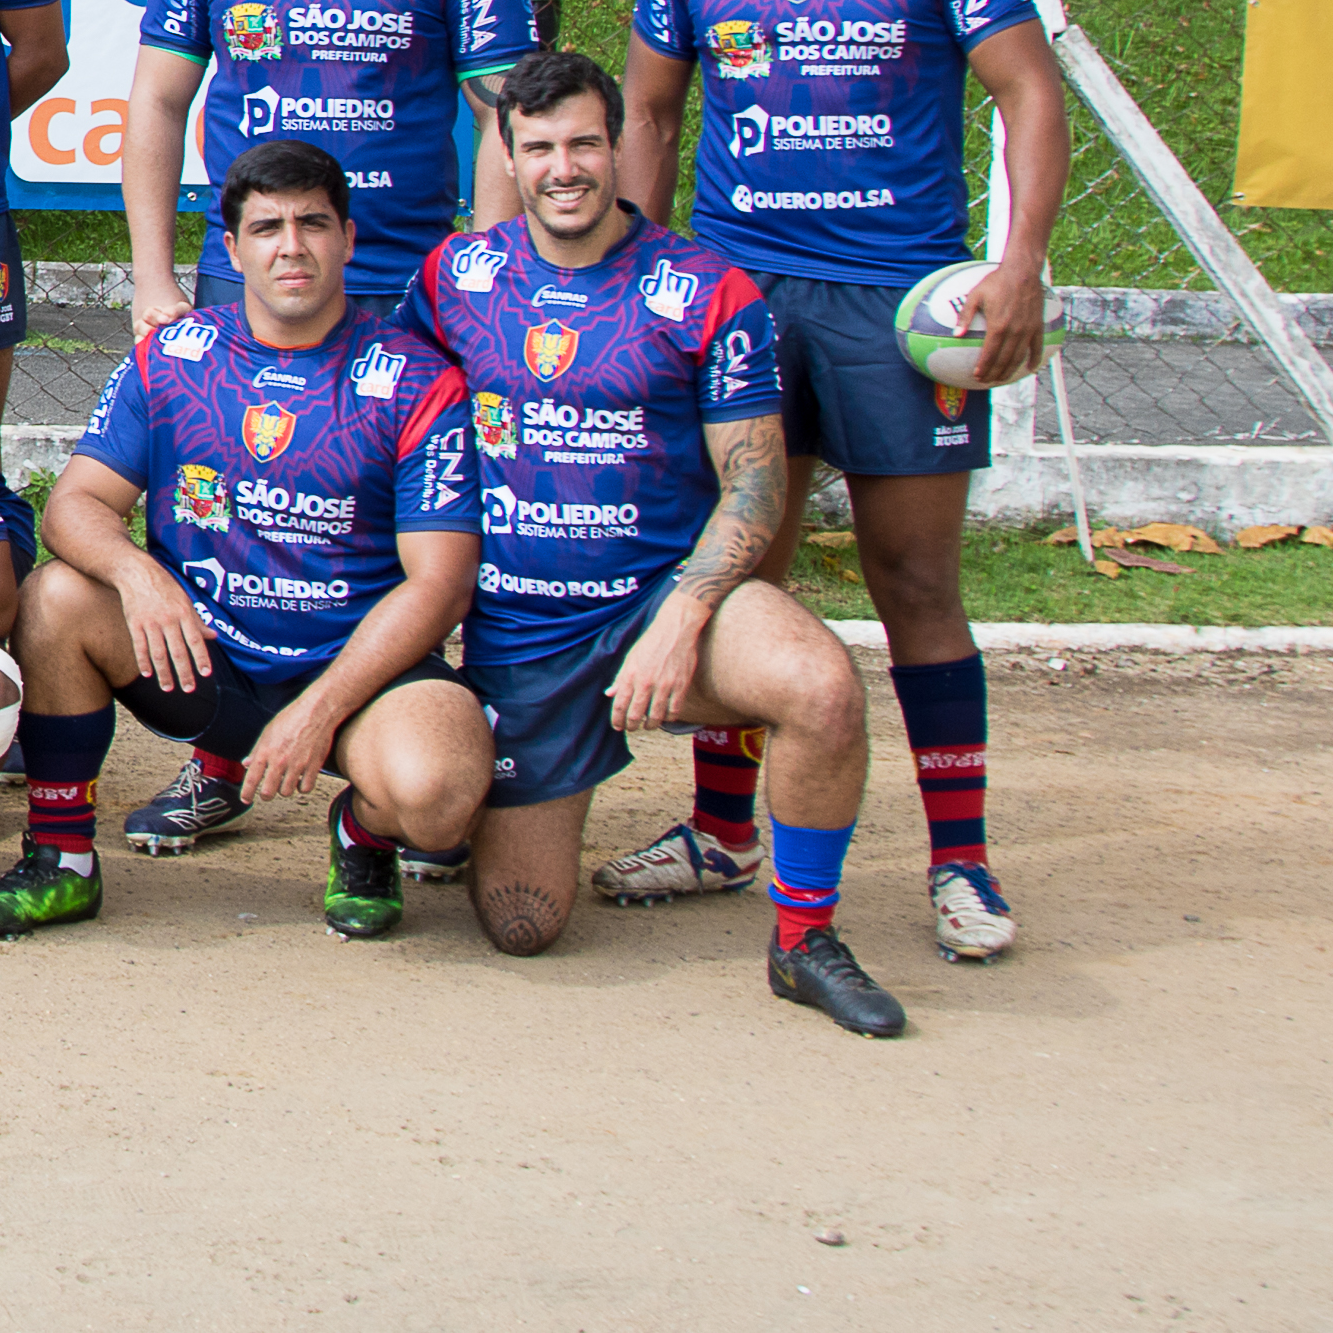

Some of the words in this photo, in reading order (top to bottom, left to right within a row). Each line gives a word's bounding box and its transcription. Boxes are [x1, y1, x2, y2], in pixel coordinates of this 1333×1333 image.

[289, 4, 345, 30] SÃO
[346, 9, 414, 36] JOSÉ
[776, 16, 836, 43] SÃO
[836, 19, 908, 44] JOSÉ
[289, 30, 329, 46] DOS
[331, 32, 411, 50] CAMPOS
[311, 50, 387, 64] PREFEITURA
[779, 45, 821, 61] DOS
[822, 44, 904, 60] CAMPOS
[801, 64, 880, 77] PREFEITURA
[281, 98, 393, 118] POLIEDRO
[281, 118, 330, 131] SISTEMA
[332, 119, 349, 131] DE
[351, 119, 395, 132] ENSINO
[771, 114, 891, 137] POLIEDRO
[773, 136, 822, 150] SISTEMA
[824, 136, 842, 149] DE
[845, 135, 893, 149] ENSINO
[753, 189, 826, 209] QUERO
[827, 189, 896, 209] BOLSA
[639, 259, 698, 304] dm
[541, 288, 588, 304] SANRAD
[648, 299, 683, 319] card
[159, 317, 218, 350] dm
[165, 341, 202, 361] card
[351, 343, 406, 388] dm
[262, 371, 307, 387] SANRAD
[358, 378, 394, 396] card
[523, 398, 579, 429] SÃO
[579, 406, 644, 432] JOSÉ
[524, 428, 563, 447] DOS
[565, 430, 648, 449] CAMPOS
[544, 451, 626, 465] PREFEITURA
[434, 427, 465, 511] CNA
[236, 479, 290, 511] SÃO
[292, 492, 356, 520] JOSÉ
[237, 506, 273, 527] DOS
[274, 514, 352, 536] CAMPOS
[517, 500, 639, 526] POLIEDRO
[257, 529, 331, 546] PREFEITURA
[517, 522, 568, 539] SISTEMA
[569, 525, 587, 539] DE
[588, 525, 639, 539] ENSINO
[227, 573, 349, 600] POLIEDRO
[501, 572, 567, 597] QUERO
[568, 577, 638, 598] BOLSA
[228, 593, 280, 609] SISTEMA
[281, 597, 298, 612] DE
